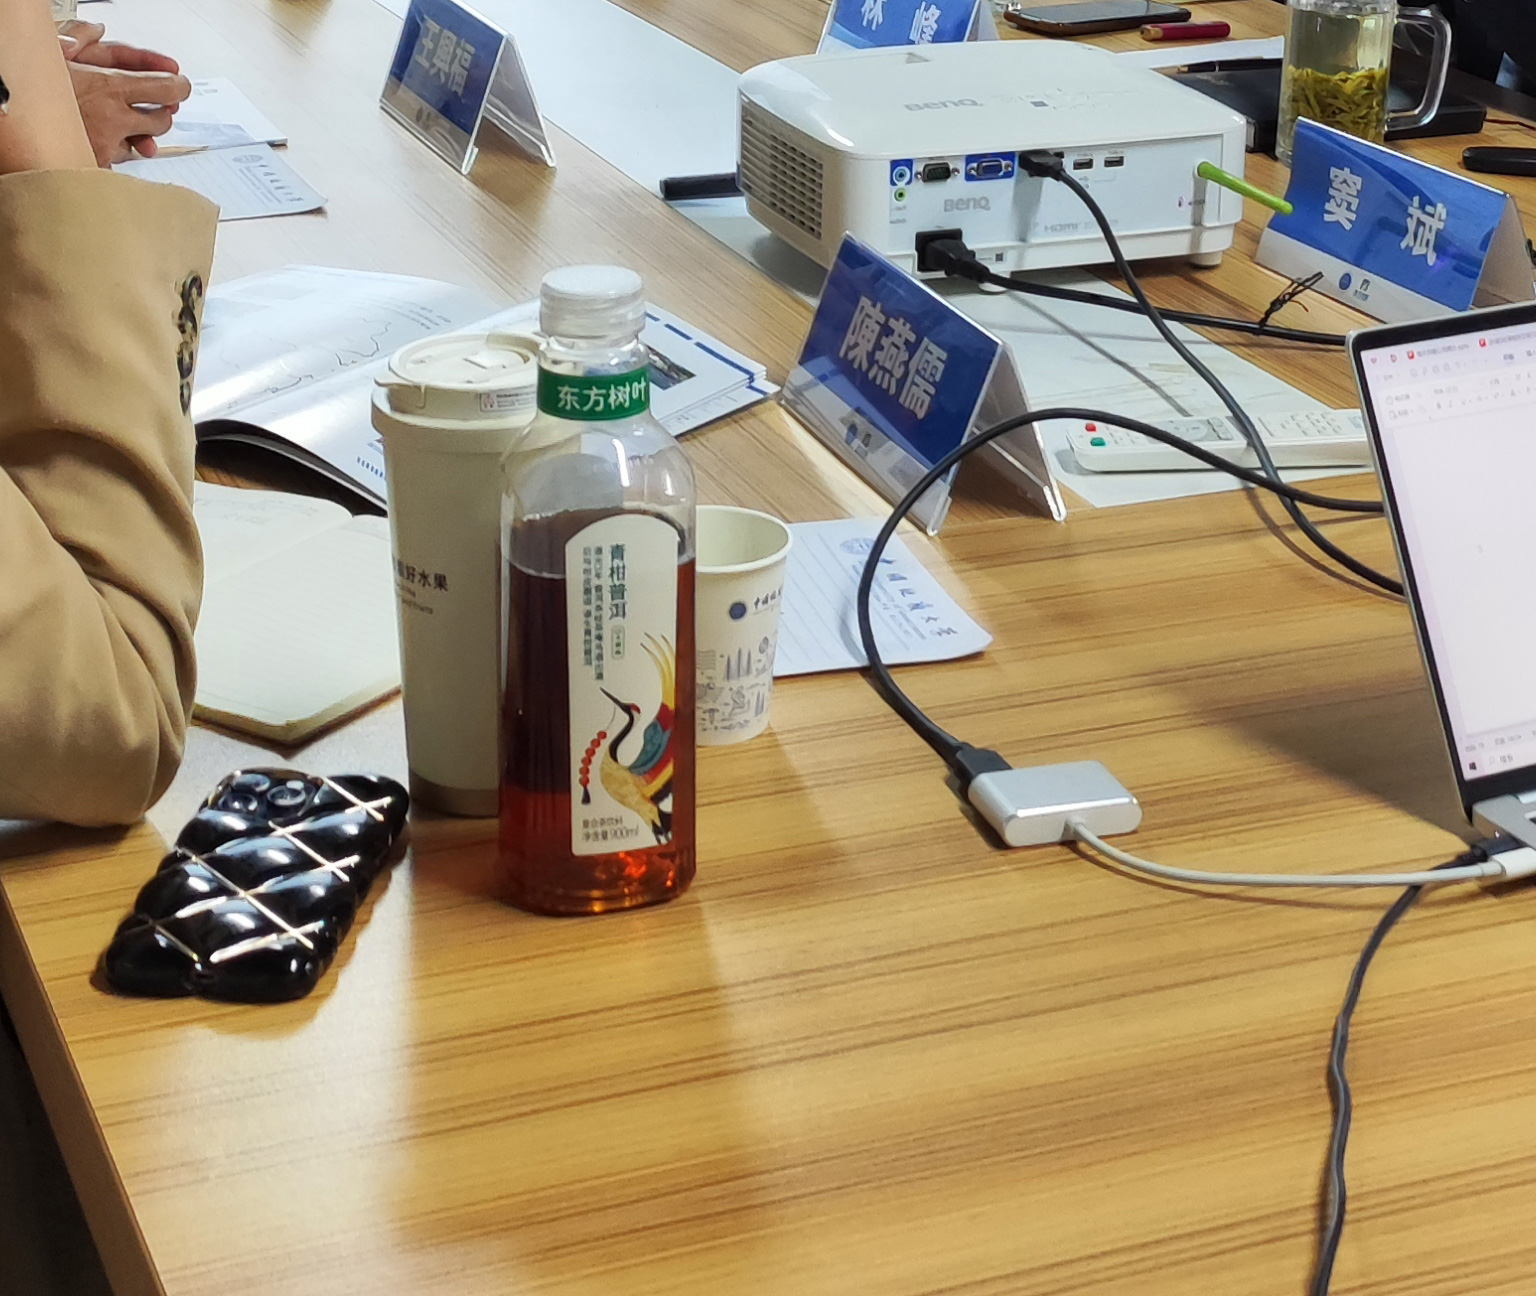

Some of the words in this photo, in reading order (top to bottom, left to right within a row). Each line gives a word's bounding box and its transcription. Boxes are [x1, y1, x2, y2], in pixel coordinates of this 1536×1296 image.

[943, 195, 991, 213] BenQ
[838, 294, 948, 421] 陳燕儒
[557, 376, 646, 412] 东方树叶
[608, 543, 628, 621] 青柑普洱
